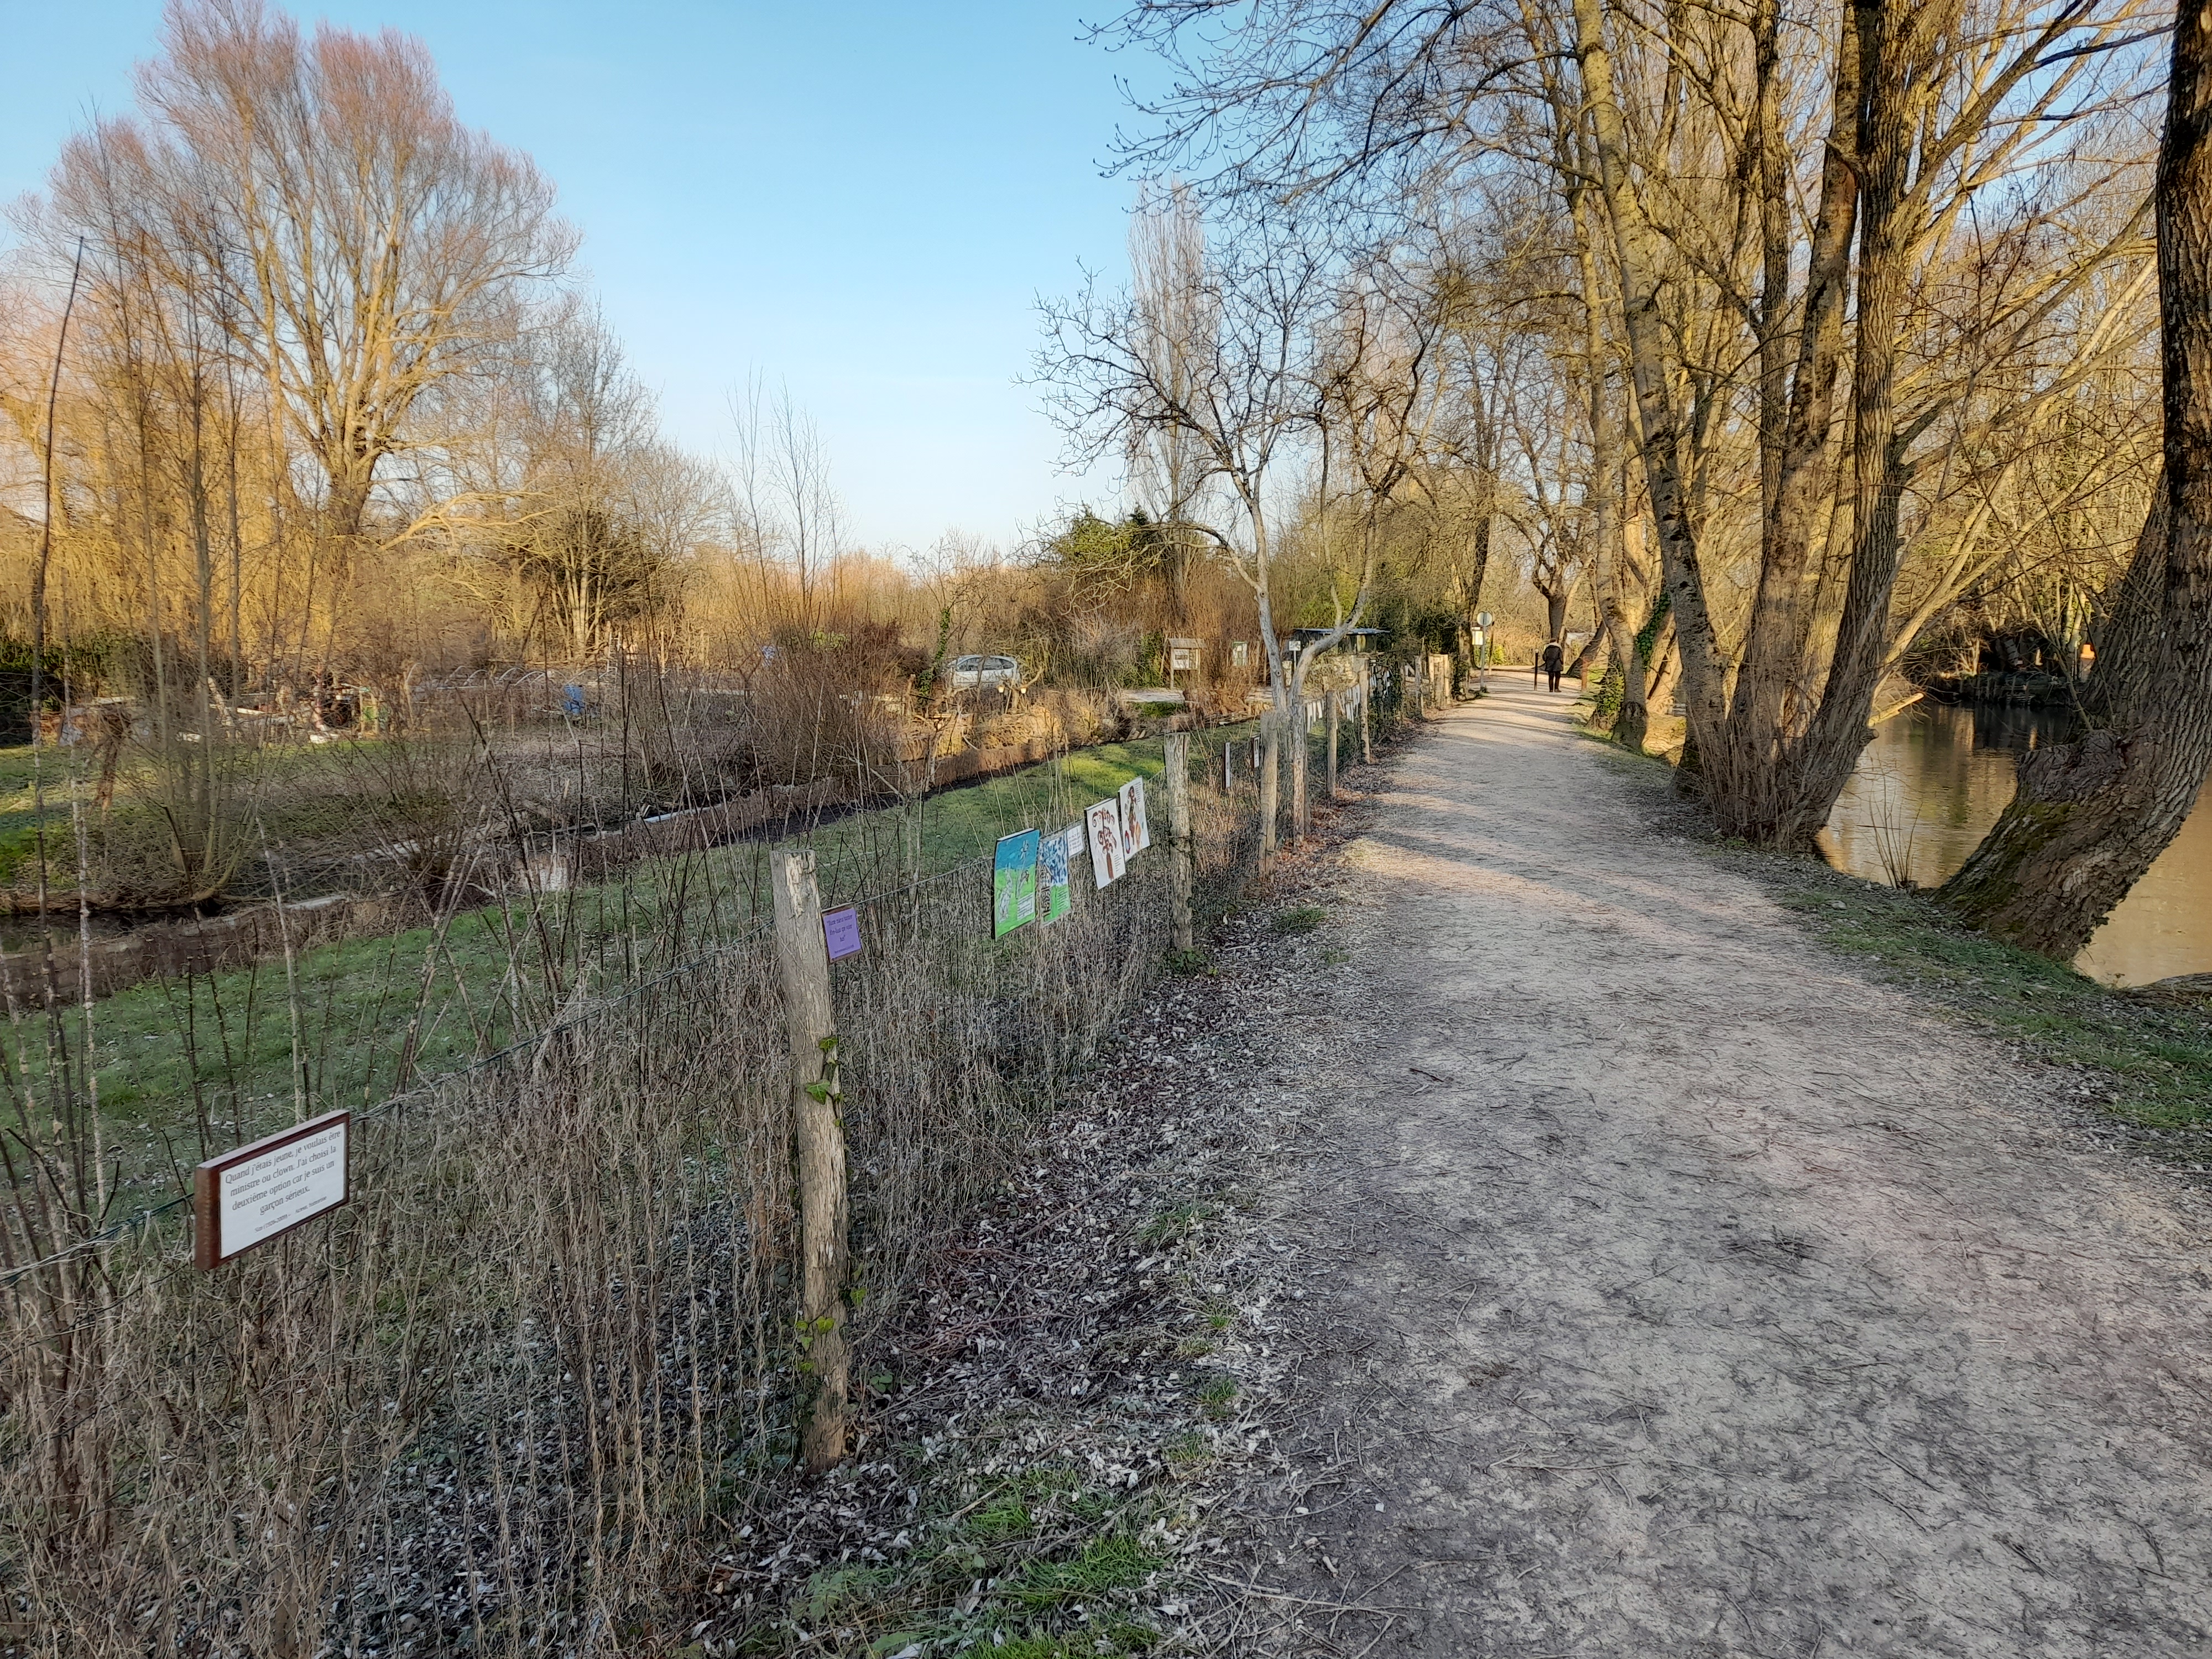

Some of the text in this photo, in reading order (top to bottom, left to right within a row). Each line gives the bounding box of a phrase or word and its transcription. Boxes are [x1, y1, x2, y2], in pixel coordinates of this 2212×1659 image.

[225, 1131, 341, 1184] Quand j'étais jeune, je voulais être
[231, 1145, 336, 1197] ministre ou clown. J'ai choisi la
[232, 1160, 335, 1211] deuxième option car je suis un
[260, 1185, 310, 1215] garçon sérieux.
